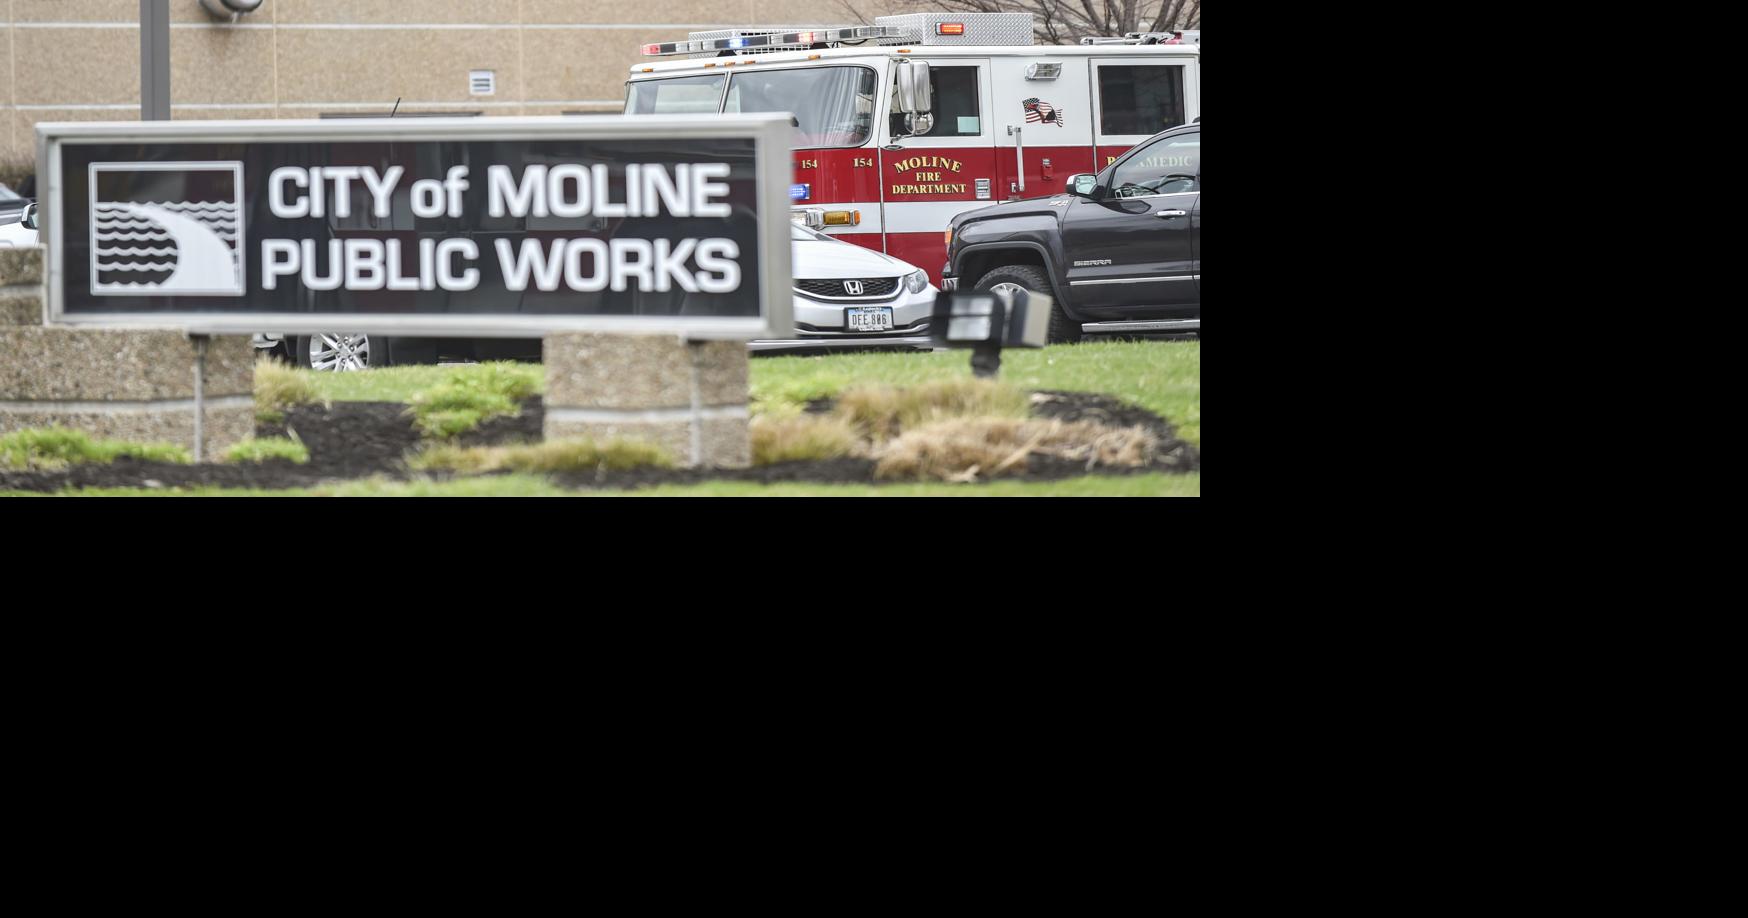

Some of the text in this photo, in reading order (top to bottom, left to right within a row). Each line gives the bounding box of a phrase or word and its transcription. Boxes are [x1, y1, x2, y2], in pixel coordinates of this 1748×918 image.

[801, 159, 817, 169] 154
[853, 158, 872, 168] 154
[894, 156, 963, 174] MOLINE
[916, 172, 942, 182] FIRE
[267, 162, 731, 219] CITY of MOLINE
[892, 184, 967, 194] DEPARTMENT
[261, 237, 742, 293] PUBLIC WORKS
